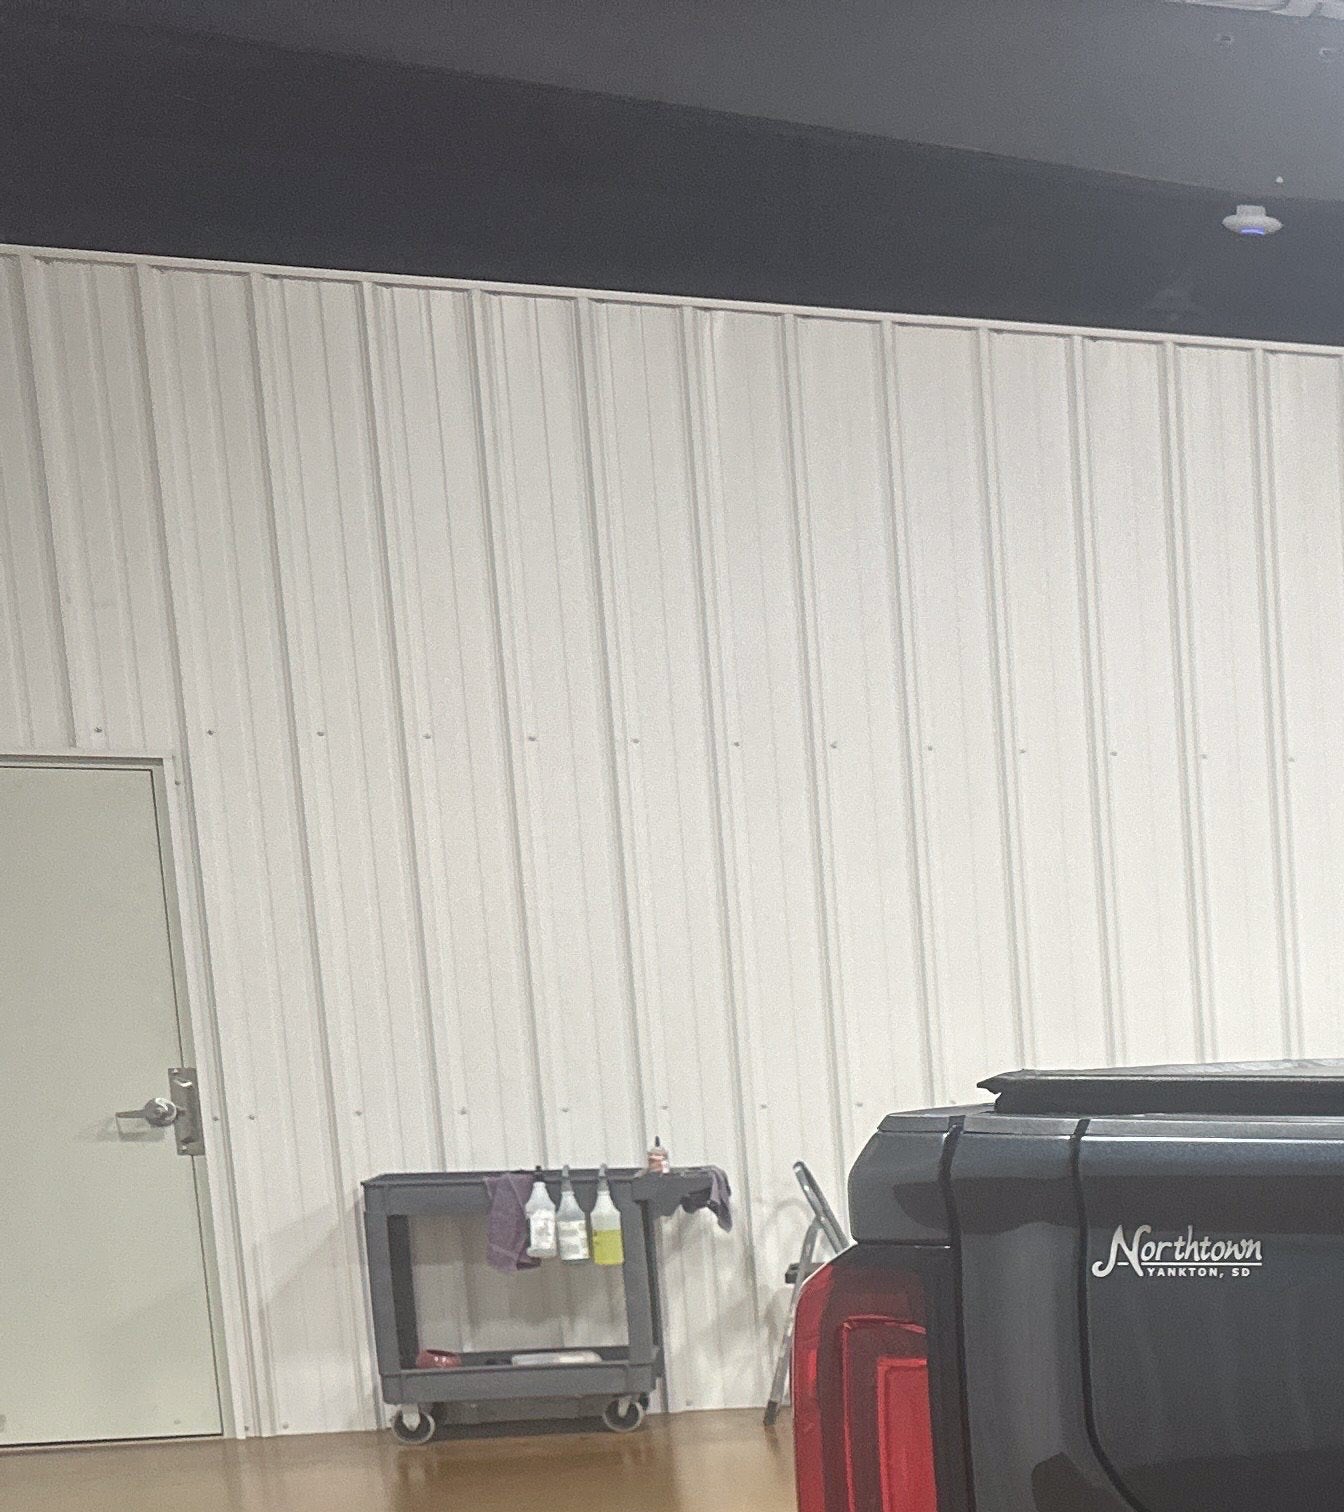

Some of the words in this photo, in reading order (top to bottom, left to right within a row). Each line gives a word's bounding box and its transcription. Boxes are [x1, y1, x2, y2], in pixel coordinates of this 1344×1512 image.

[1091, 1224, 1263, 1278] Northtown
[1147, 1267, 1225, 1279] YANKTON,
[1231, 1267, 1251, 1278] SD
